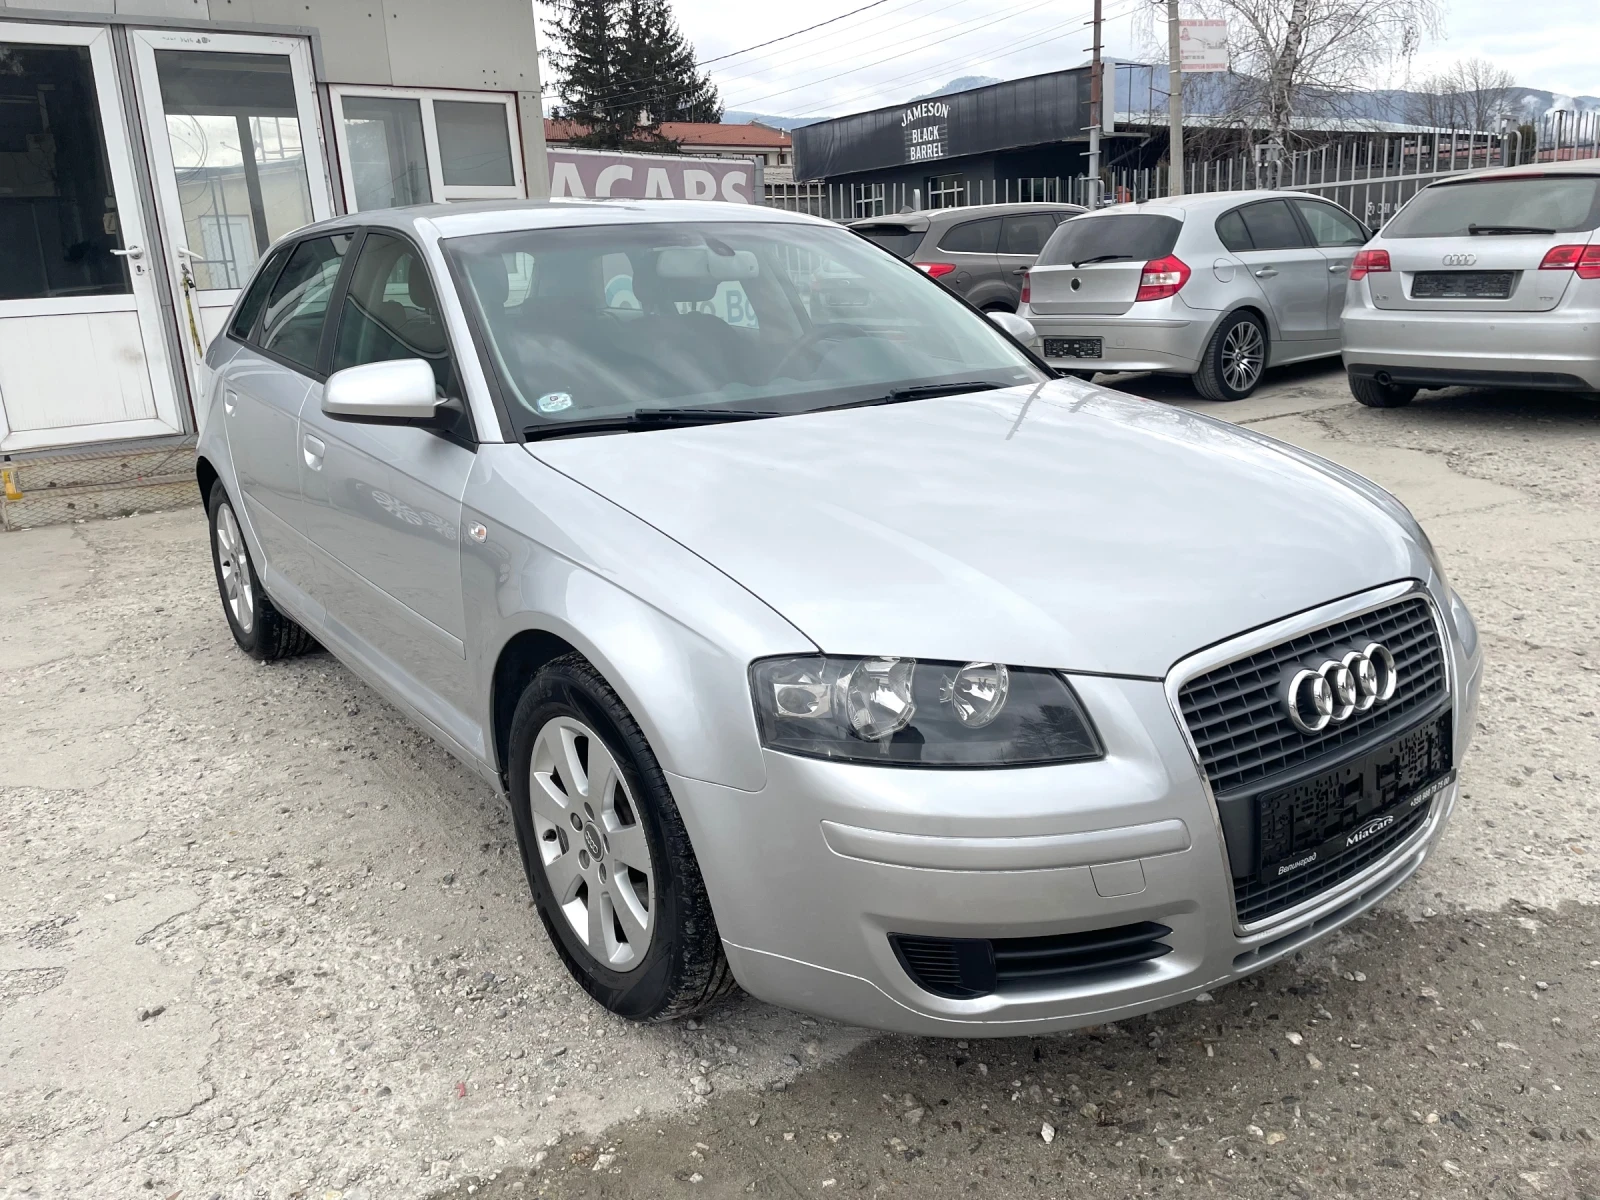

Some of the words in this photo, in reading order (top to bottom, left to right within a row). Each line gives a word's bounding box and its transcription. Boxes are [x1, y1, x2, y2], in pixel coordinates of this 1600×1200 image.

[901, 102, 949, 127] JAMESON
[912, 125, 939, 144] BLACK
[910, 142, 944, 160] BARREL
[1346, 817, 1394, 847] MiaCars
